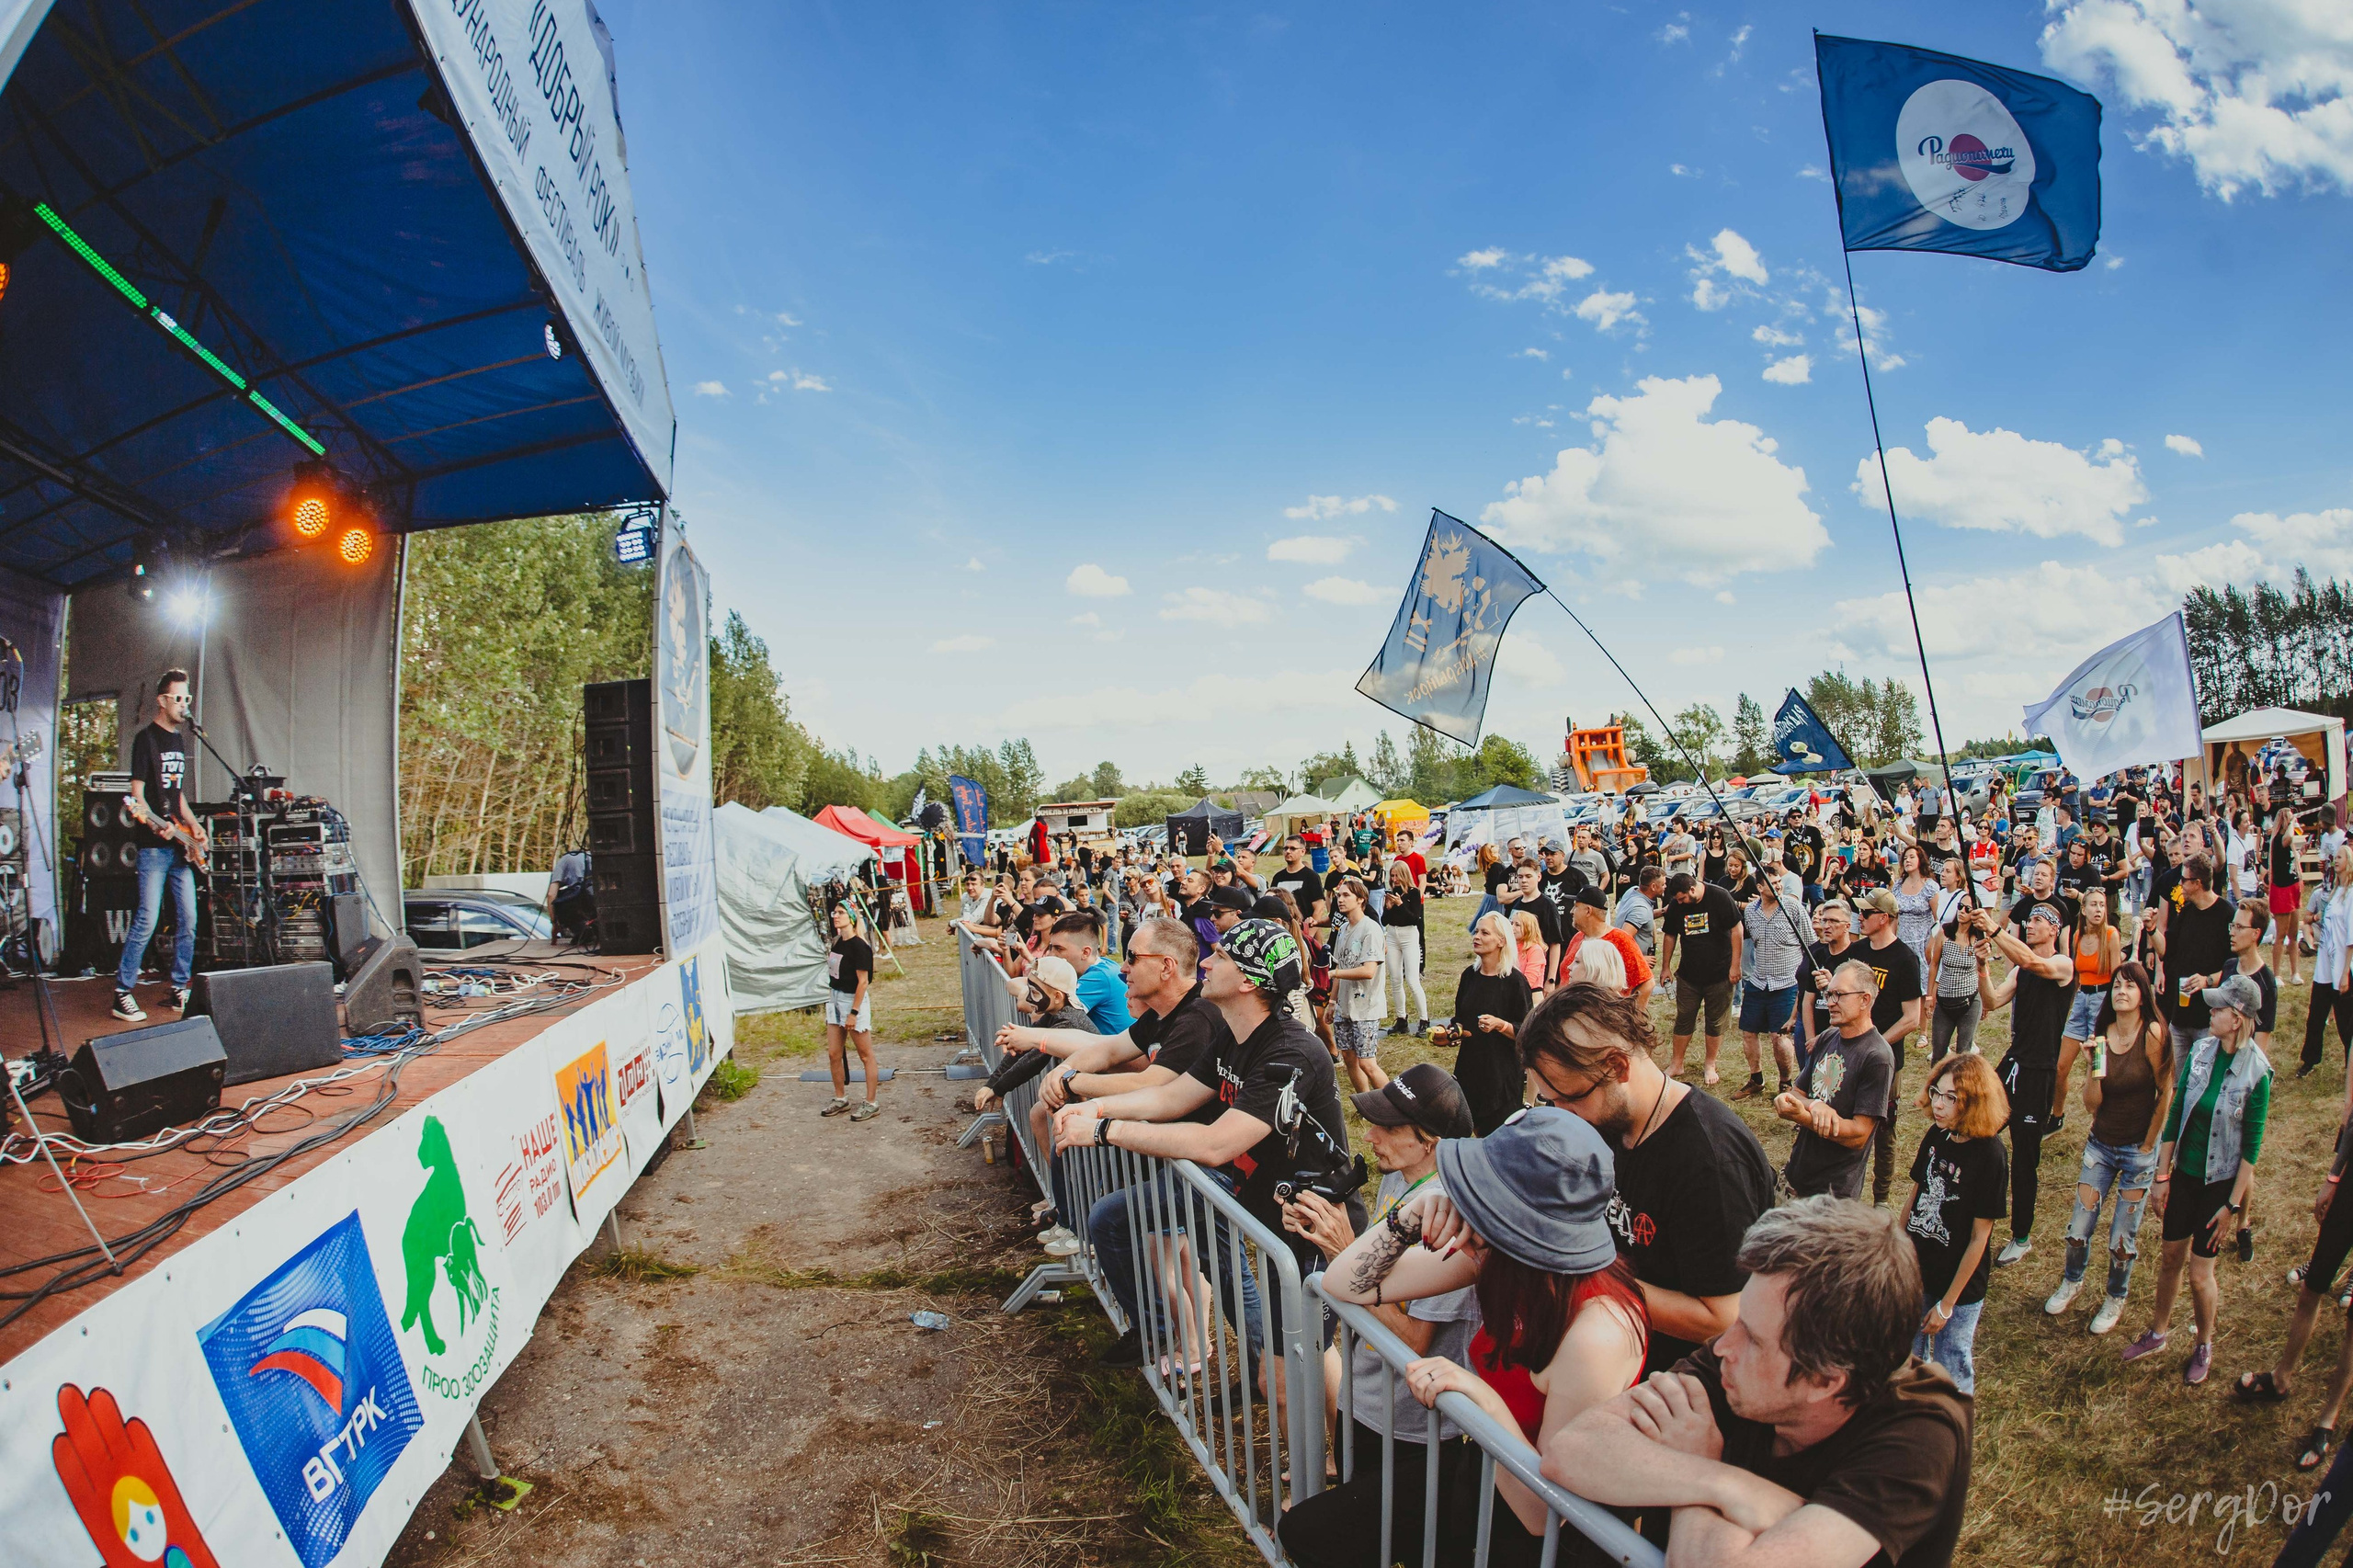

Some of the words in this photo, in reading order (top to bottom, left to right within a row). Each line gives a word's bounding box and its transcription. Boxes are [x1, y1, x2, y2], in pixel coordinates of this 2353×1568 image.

[535, 165, 585, 294] ФЕСТИВАЛЬ
[1068, 806, 1102, 814] РАДОСТЬ
[519, 1112, 558, 1171] НАШЕ
[529, 1158, 557, 1195] РАДИО
[534, 1186, 553, 1220] 103.0
[422, 1364, 460, 1400] ПРОО
[461, 1286, 501, 1397] ЗООЗАЩИТА
[301, 1385, 388, 1505] ВГТРК
